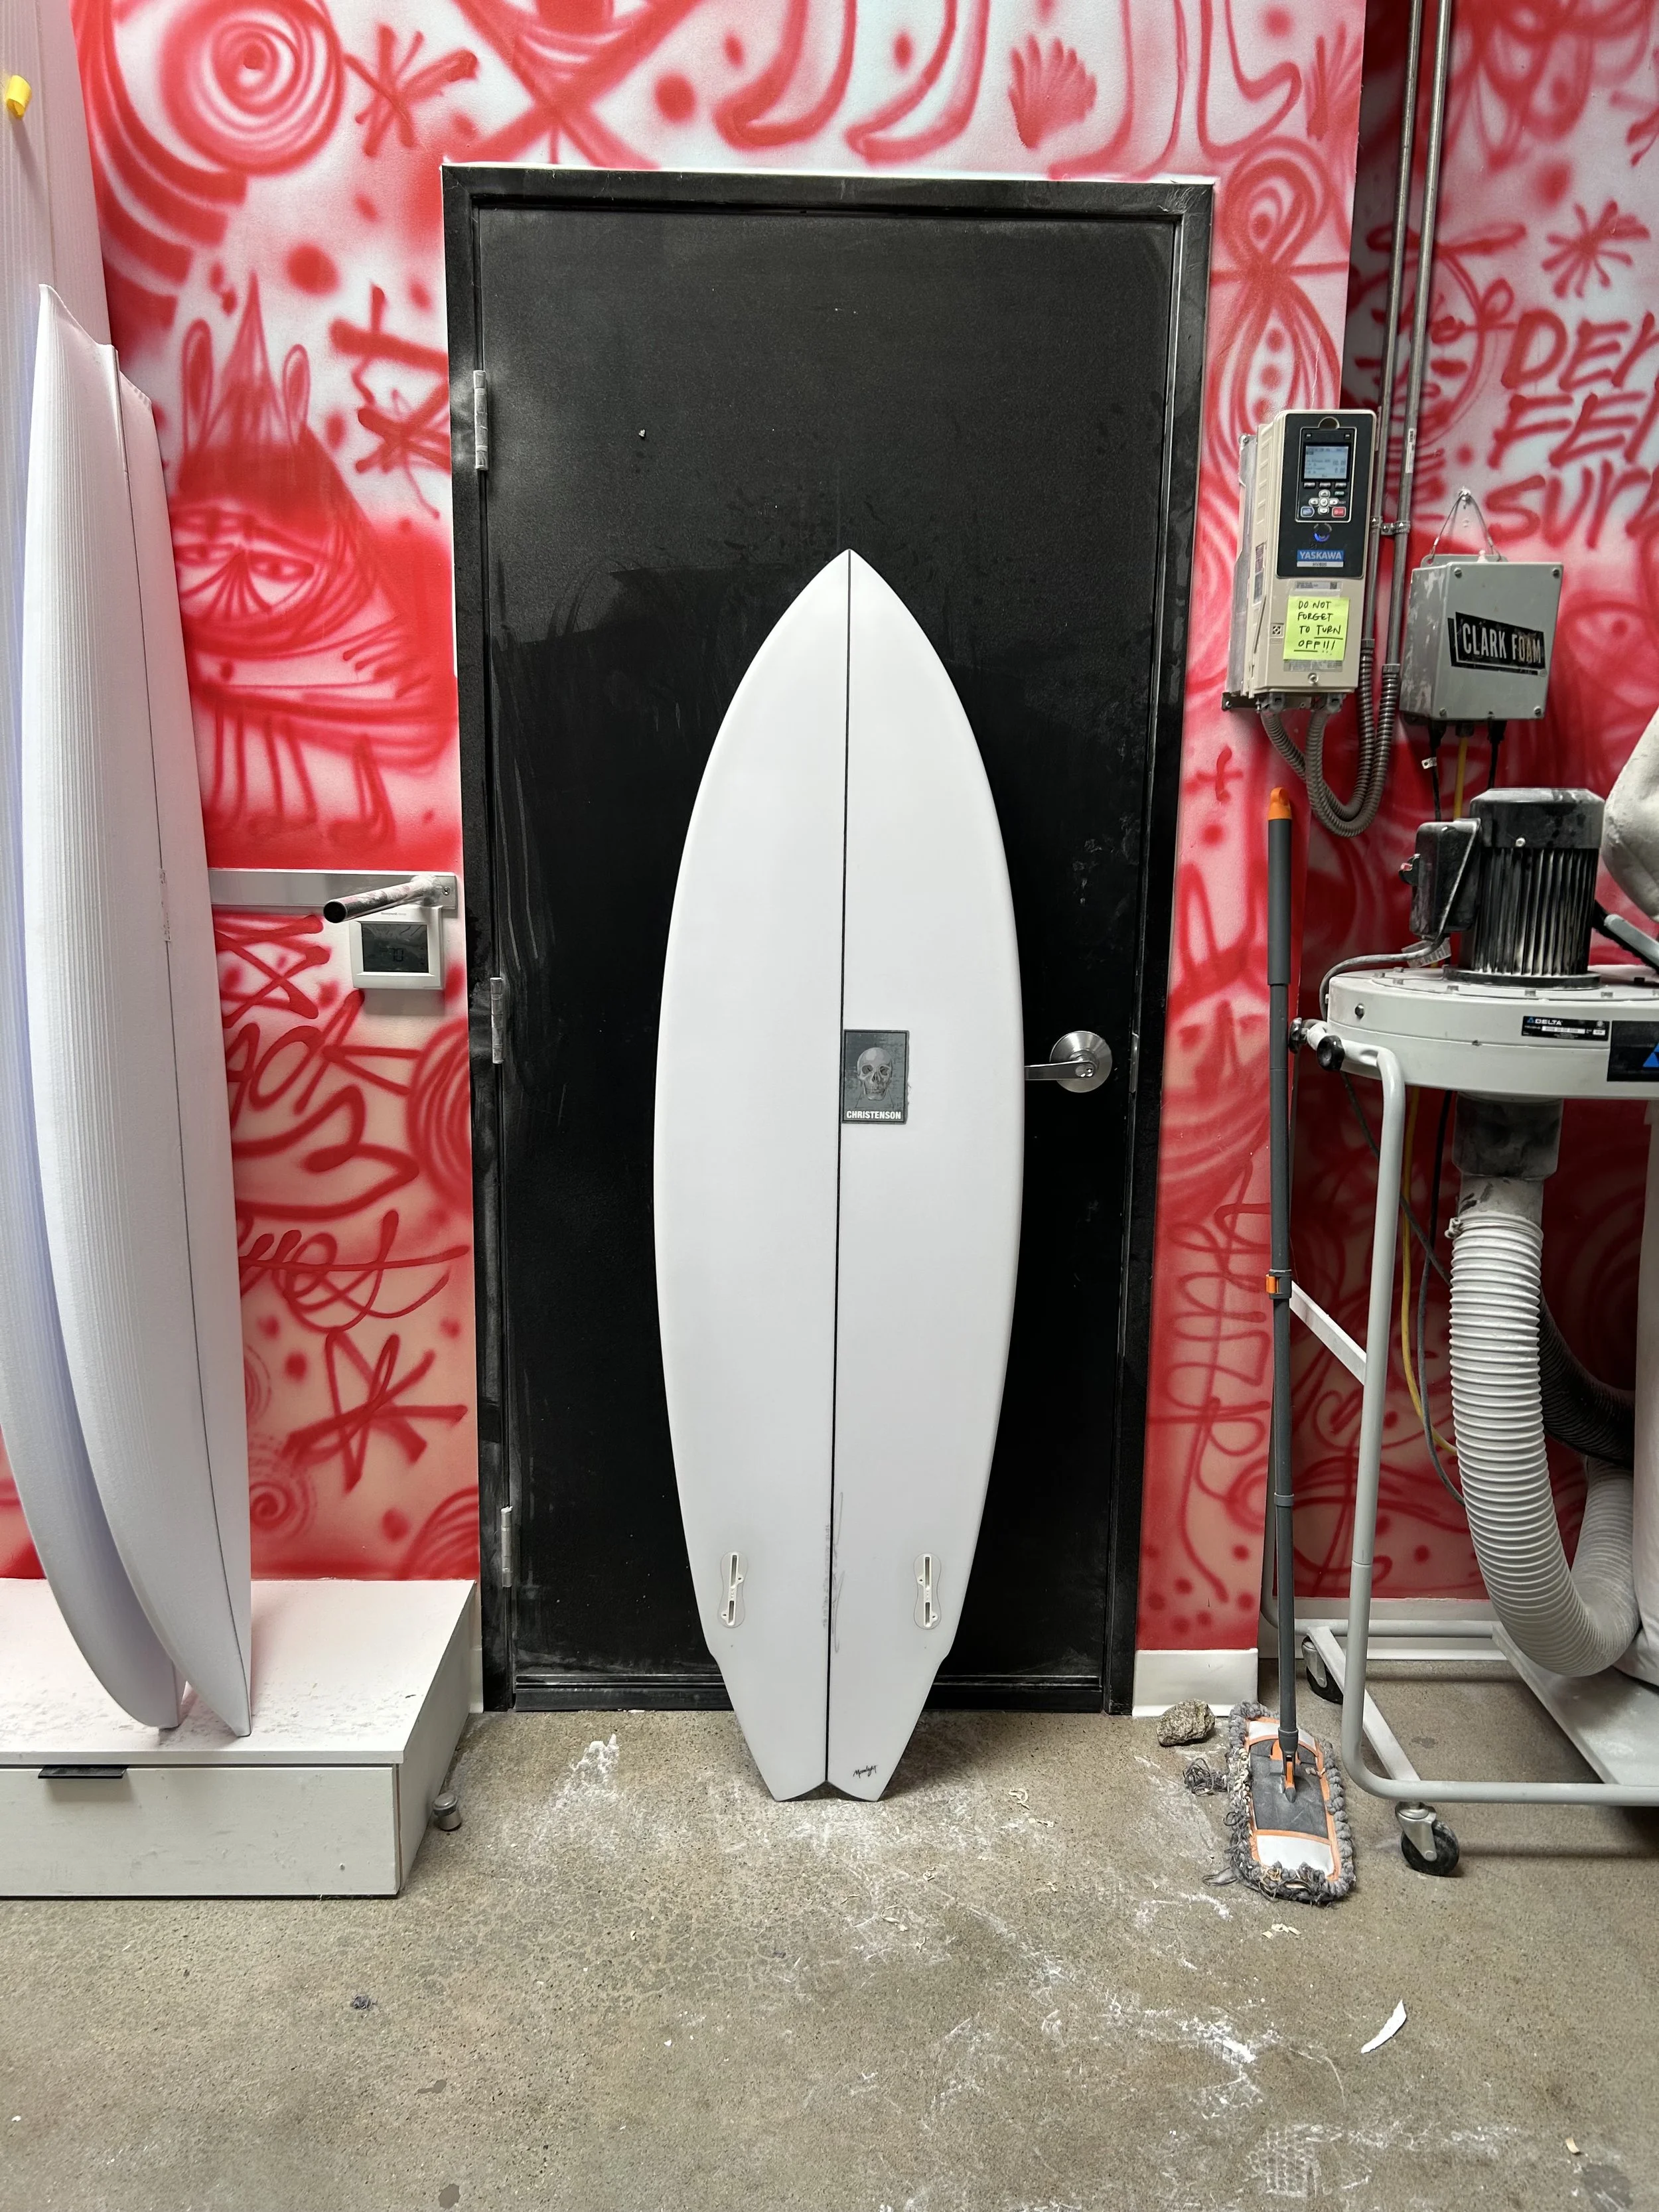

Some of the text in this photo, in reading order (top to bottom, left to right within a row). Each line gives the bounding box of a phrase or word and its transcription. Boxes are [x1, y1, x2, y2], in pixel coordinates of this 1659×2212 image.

[1298, 600, 1332, 609] DO NOT
[1297, 611, 1334, 621] FORGET
[1299, 625, 1341, 635] TO TURN
[1462, 623, 1542, 664] CLARK FOAM
[846, 1110, 902, 1120] CHRISTENSON
